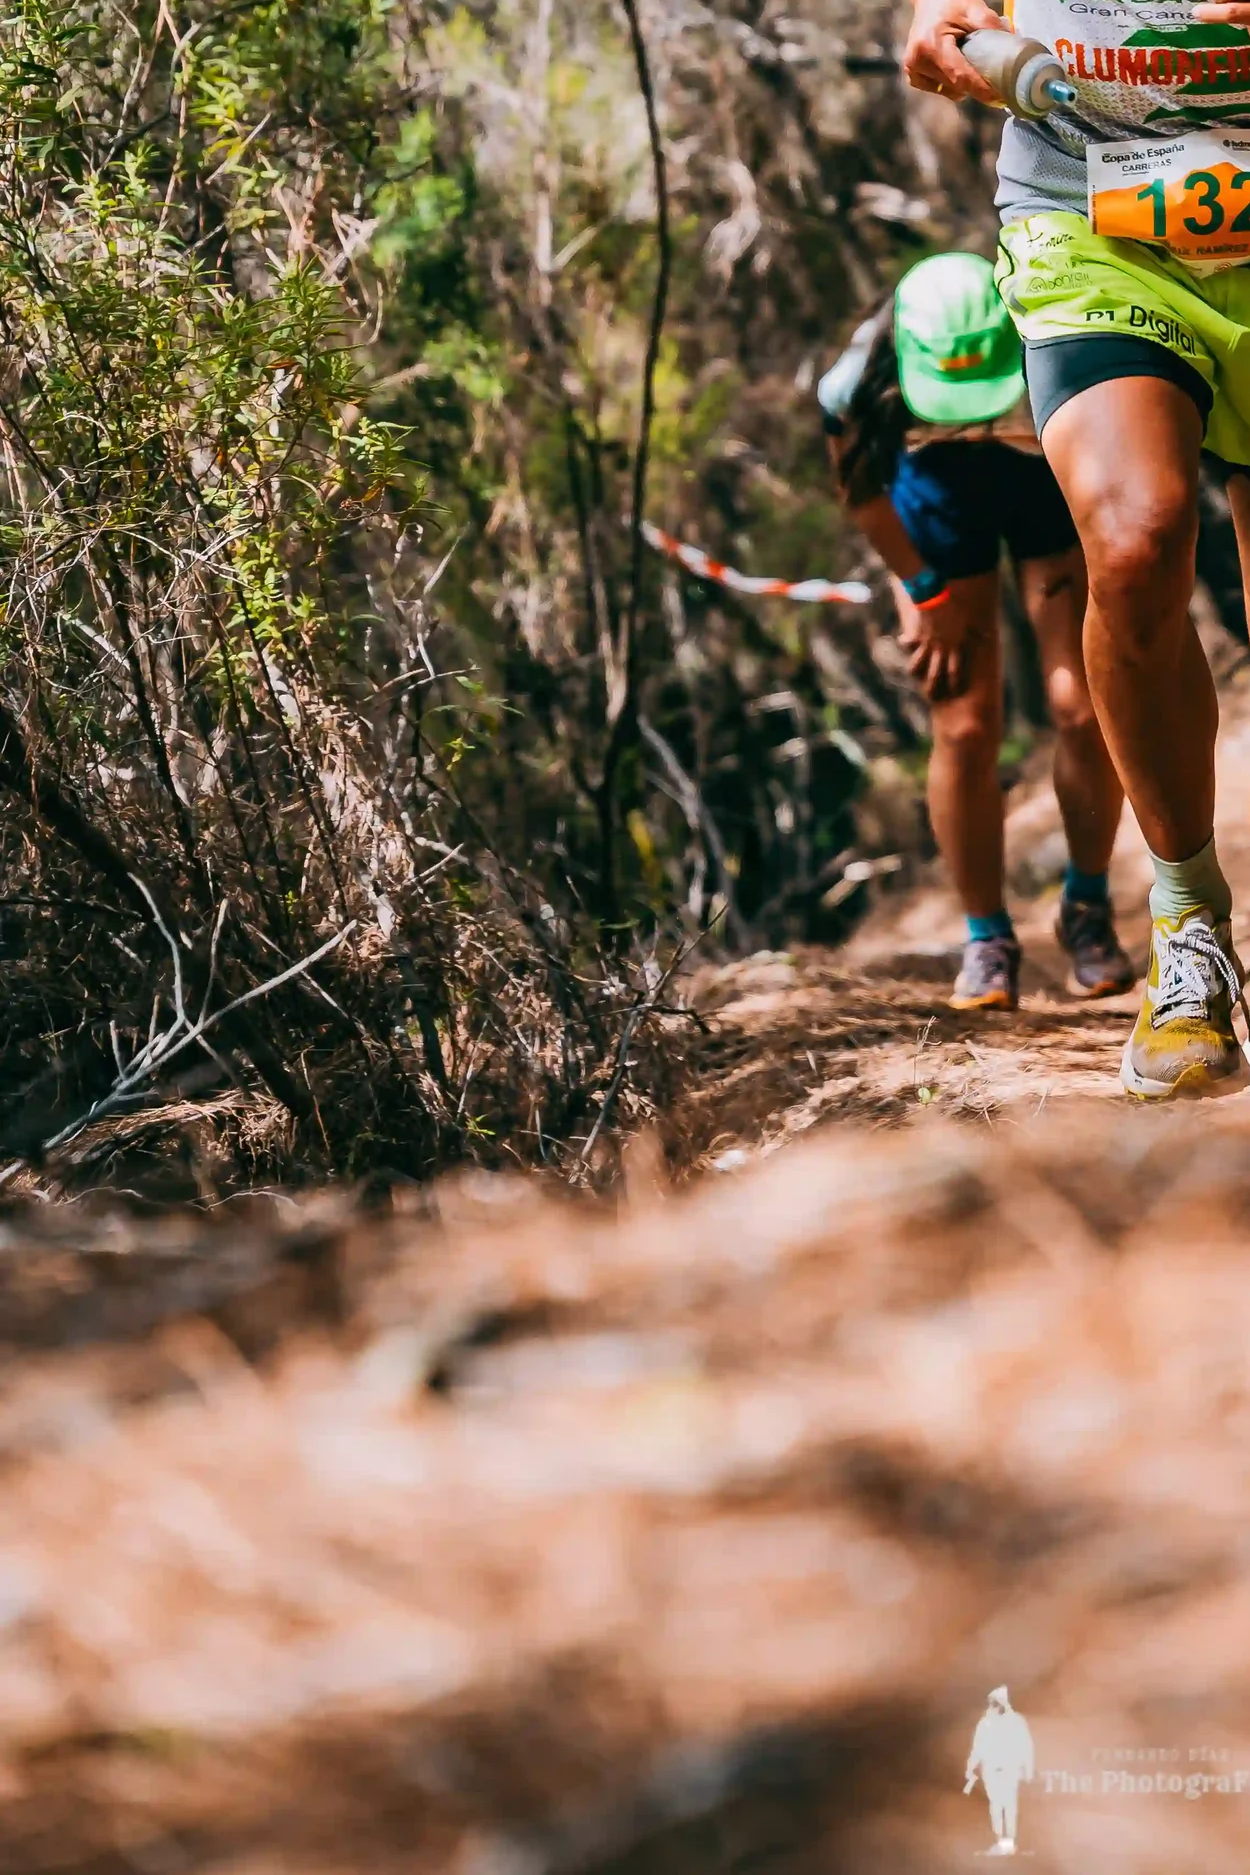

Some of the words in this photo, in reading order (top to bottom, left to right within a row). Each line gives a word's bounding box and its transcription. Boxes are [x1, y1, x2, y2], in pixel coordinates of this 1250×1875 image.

[1069, 2, 1128, 18] Gran
[1101, 152, 1131, 164] Copa
[1132, 151, 1146, 161] de
[1147, 144, 1186, 158] España
[1122, 158, 1173, 173] CARRERAS
[1129, 305, 1197, 357] Digital
